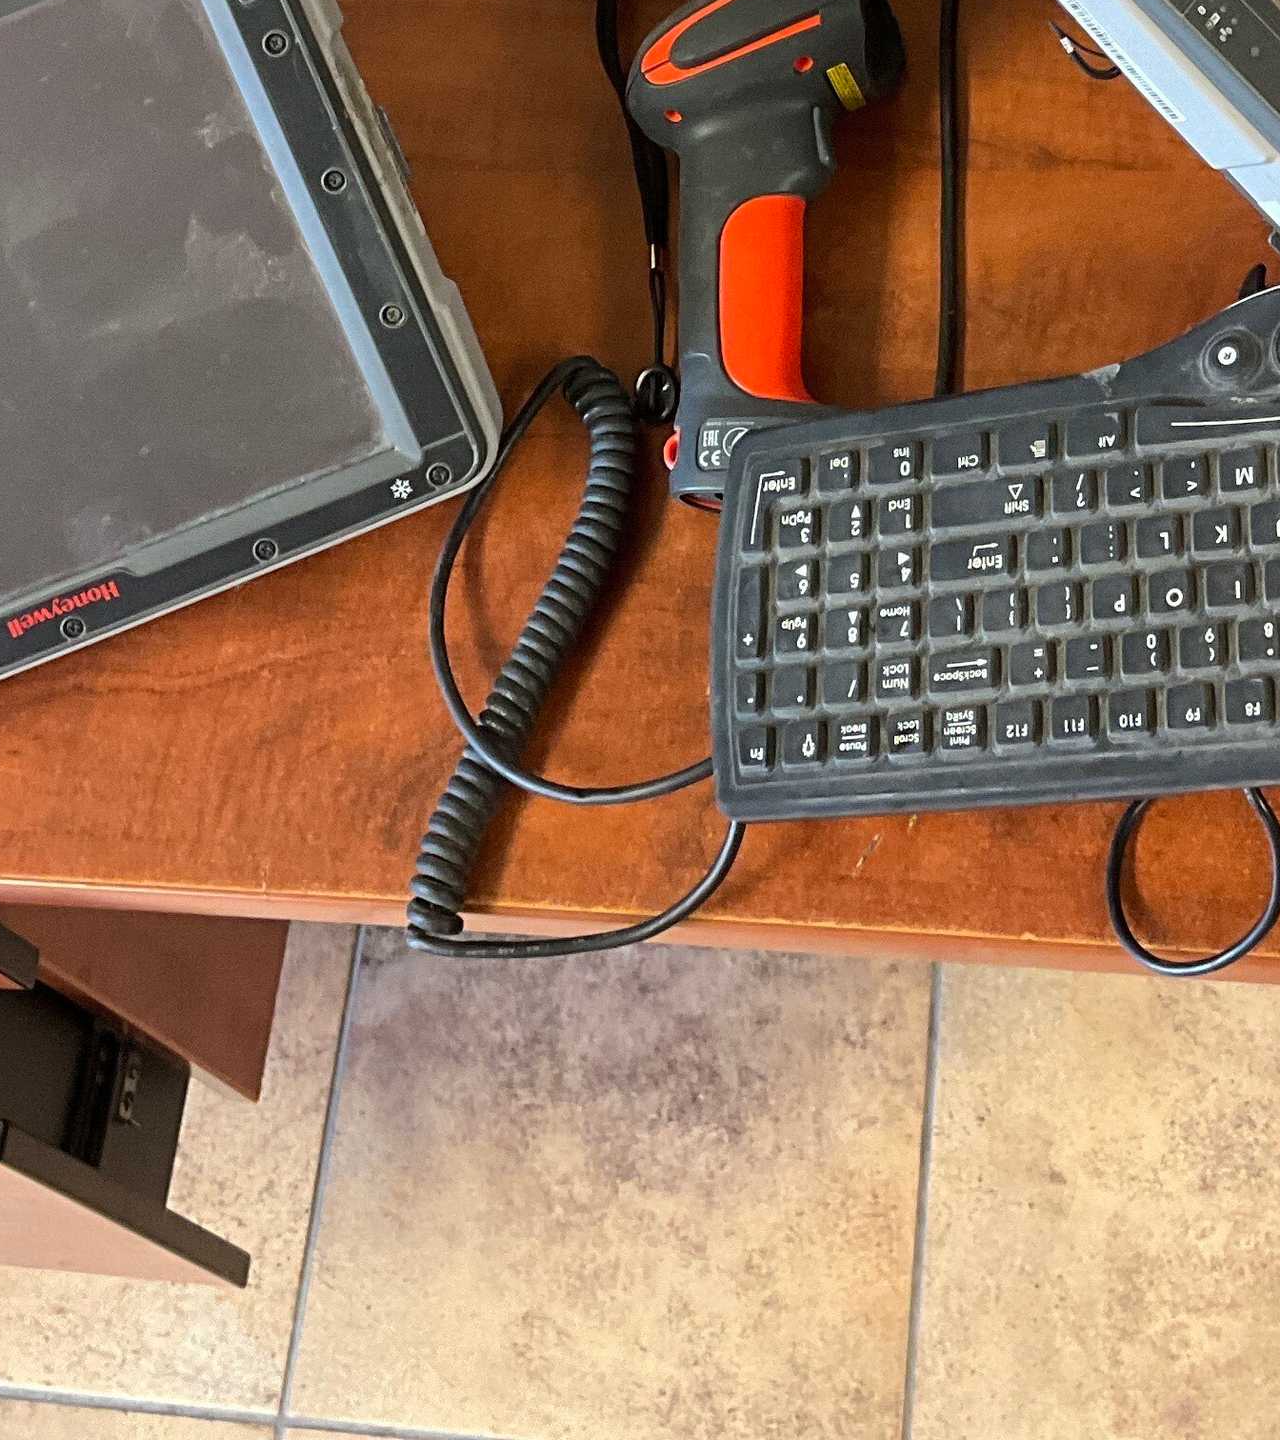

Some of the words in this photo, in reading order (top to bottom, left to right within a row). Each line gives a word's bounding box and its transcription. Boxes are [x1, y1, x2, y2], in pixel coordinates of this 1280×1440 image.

[1098, 435, 1115, 447] Alt
[699, 450, 721, 467] CE
[894, 447, 909, 457] Ins
[830, 457, 848, 470] Del
[958, 455, 978, 468] Ctrl
[1236, 467, 1253, 485] M
[763, 476, 795, 492] Enter
[889, 498, 910, 512] End
[1005, 500, 1029, 513] Shift
[782, 511, 811, 526] PgDn
[1160, 532, 1169, 549] L
[968, 555, 1002, 570] Enter
[1166, 588, 1183, 607] O
[6, 579, 120, 639] Honeywell
[880, 606, 910, 617] Home
[782, 617, 807, 630] PgUp
[883, 664, 909, 676] Lock
[934, 669, 987, 681] BackSpace
[883, 677, 909, 689] Num
[946, 710, 973, 721] SysRq
[1186, 708, 1200, 721] F9
[1245, 702, 1260, 716] F8
[898, 720, 919, 731] Lock
[1065, 718, 1084, 732] F11
[1119, 713, 1141, 727] F10
[841, 724, 866, 734] Break
[944, 725, 976, 735] Screen
[1007, 724, 1028, 737] F12
[894, 733, 919, 744] Scroll
[950, 736, 969, 745] Print
[839, 742, 866, 751] Pause
[750, 748, 763, 760] Fn
